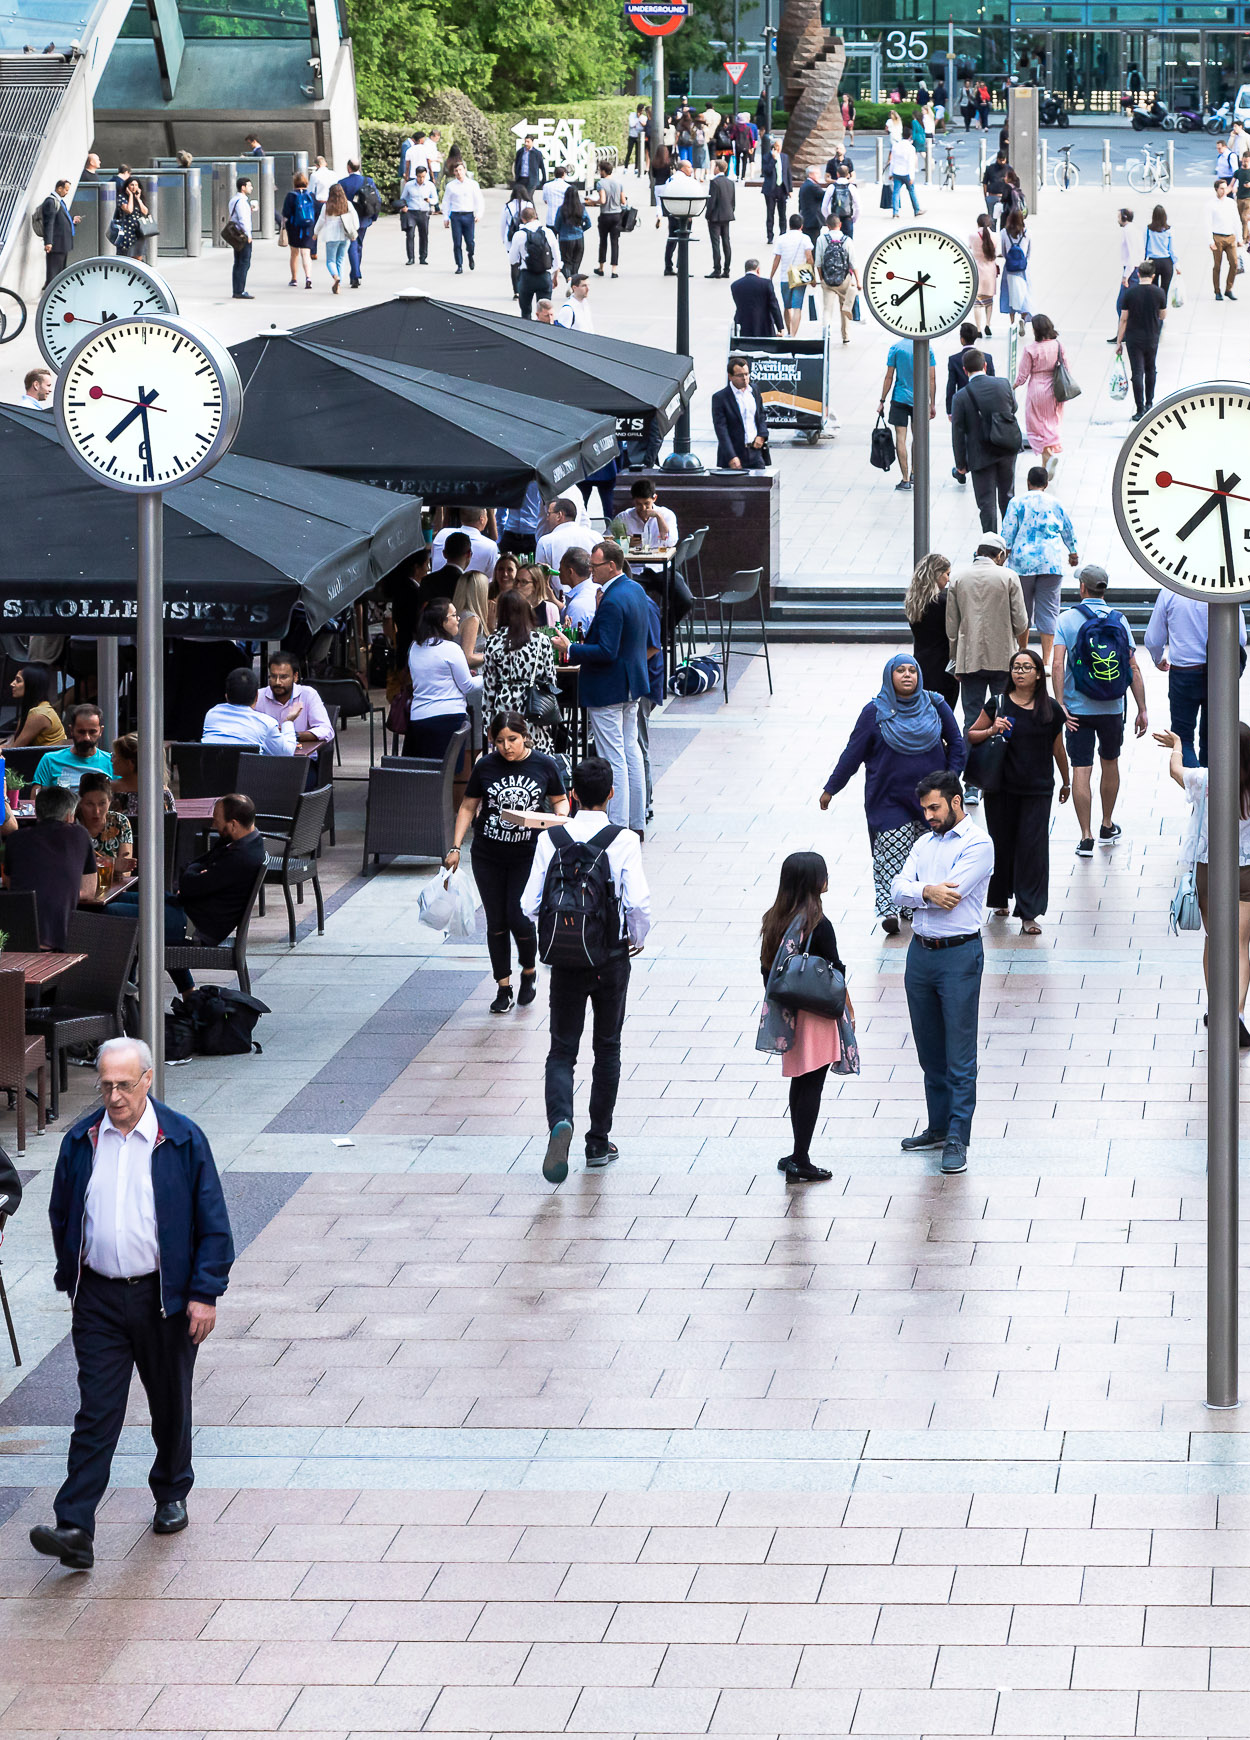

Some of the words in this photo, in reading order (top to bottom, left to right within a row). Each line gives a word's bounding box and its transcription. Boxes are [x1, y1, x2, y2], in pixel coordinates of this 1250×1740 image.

[628, 5, 686, 14] UNDERGROUND
[886, 30, 928, 61] 35
[538, 118, 586, 139] EAT
[516, 138, 592, 162] RINK
[133, 300, 144, 316] 2
[890, 293, 900, 306] 8
[750, 371, 802, 381] Standard
[751, 361, 797, 374] Evening
[3, 599, 270, 624] SMOLLESKY'S
[487, 775, 542, 797] BREAKING
[483, 824, 532, 843] BENJAMIN
